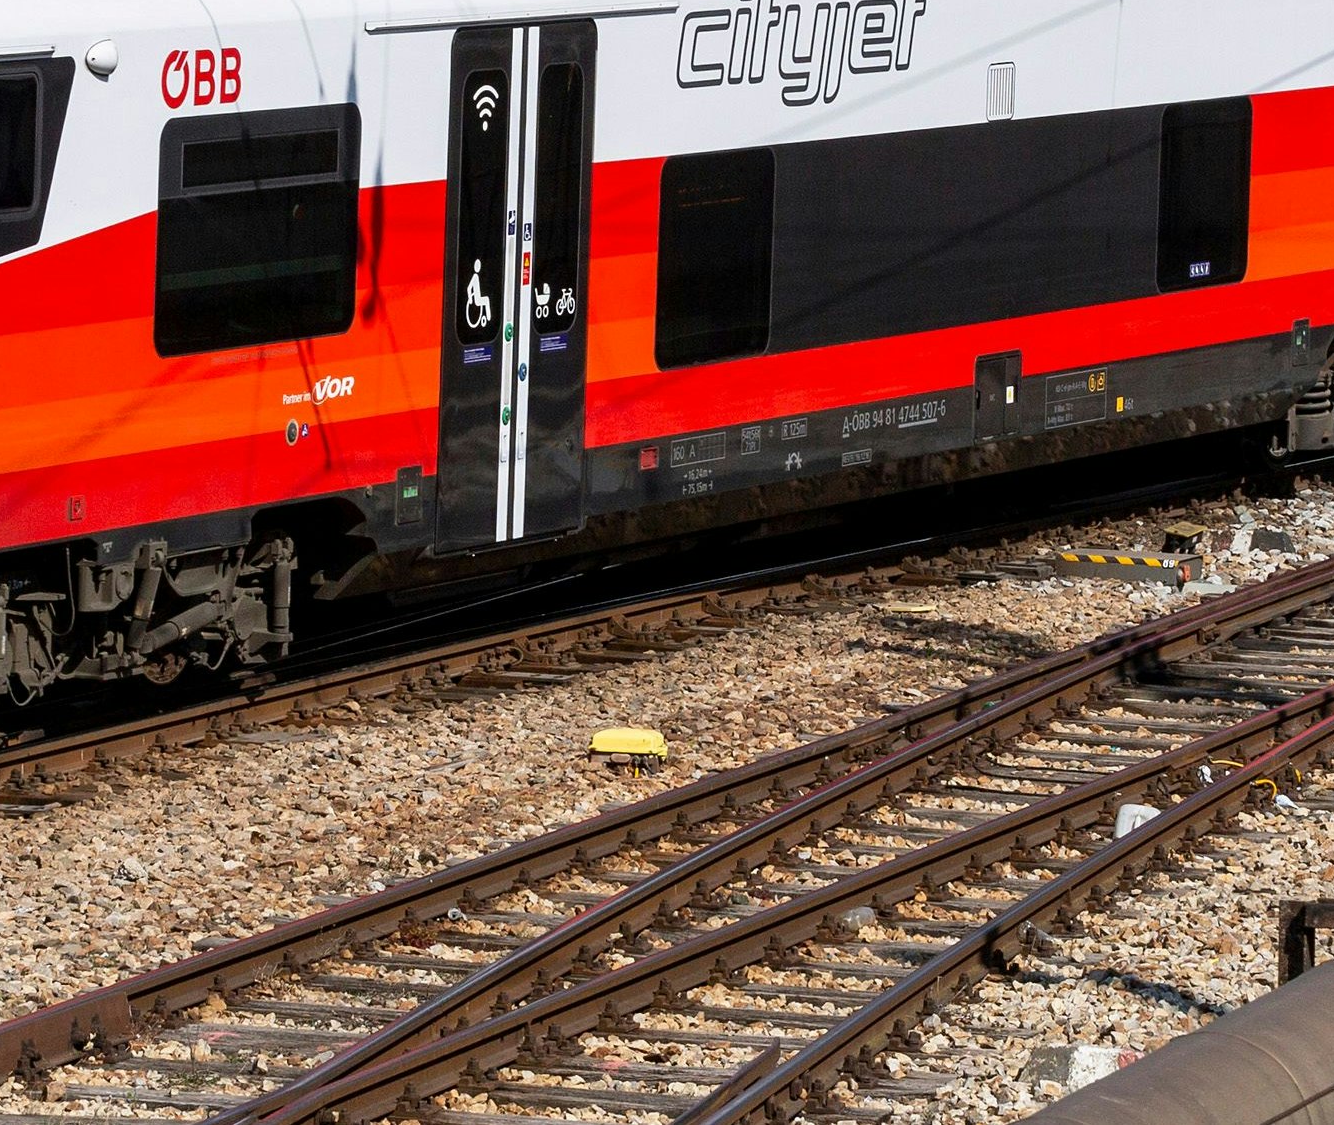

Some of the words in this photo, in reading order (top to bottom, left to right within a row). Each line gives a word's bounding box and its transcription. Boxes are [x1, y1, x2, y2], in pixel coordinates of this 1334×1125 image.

[161, 47, 242, 109] ÖBB
[313, 375, 355, 404] VOR
[842, 411, 870, 434] A-ÖBB
[872, 410, 883, 428] 94
[885, 408, 896, 425] 81
[898, 403, 920, 423] 4744
[922, 399, 946, 419] 507-6
[673, 445, 685, 461] 160
[689, 444, 696, 458] A
